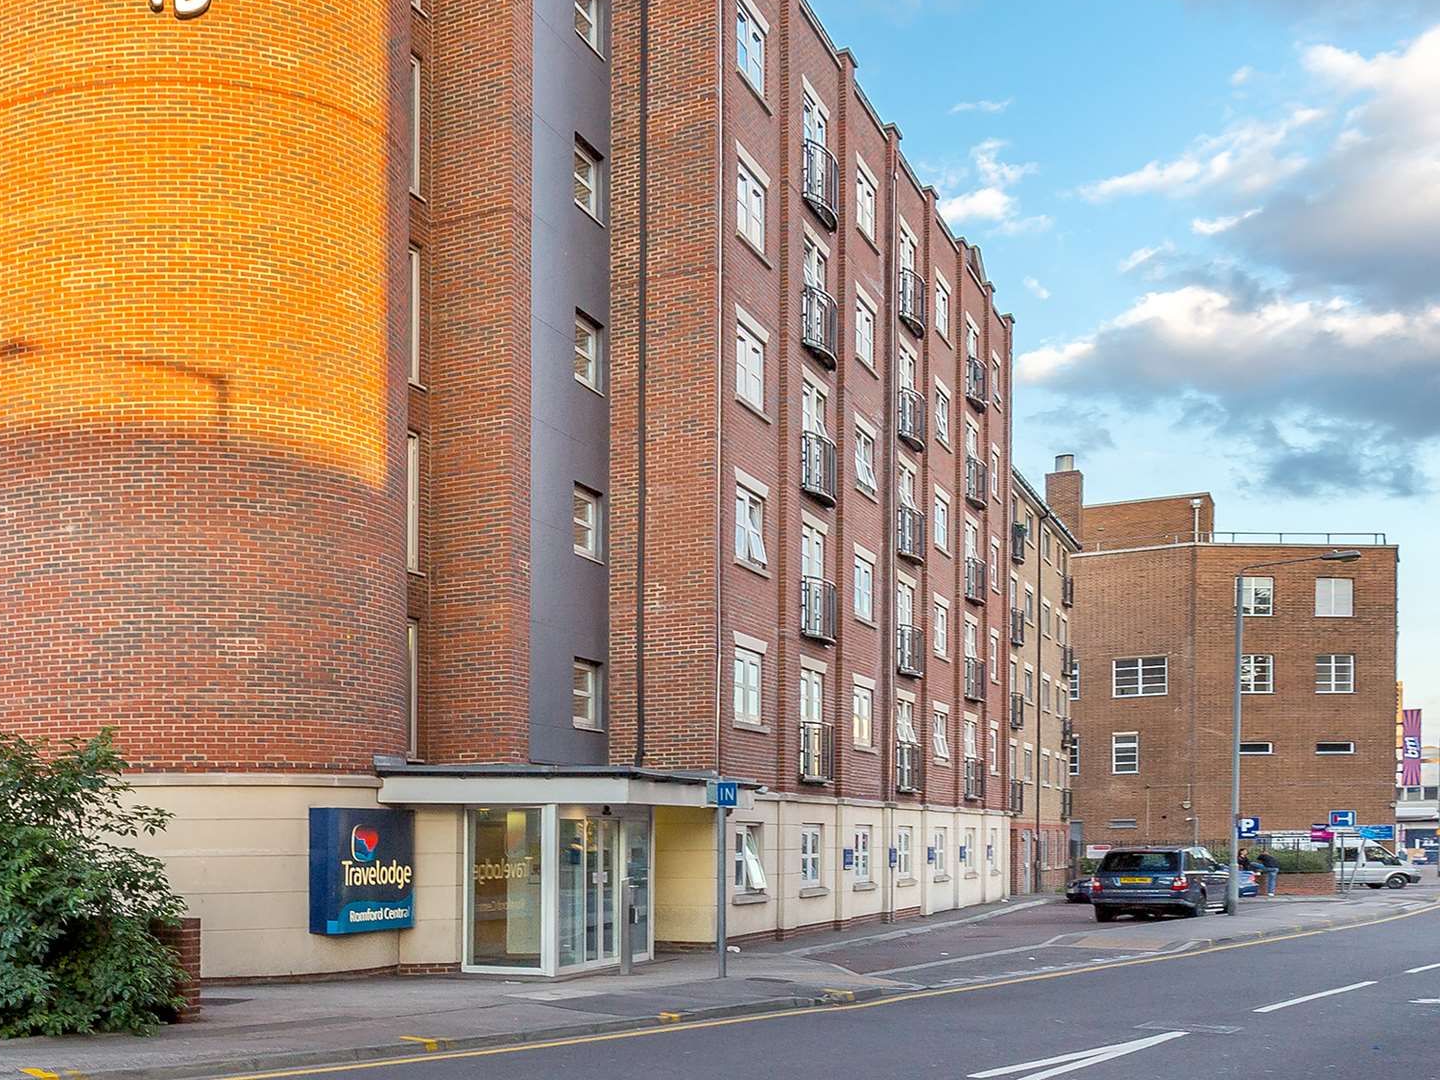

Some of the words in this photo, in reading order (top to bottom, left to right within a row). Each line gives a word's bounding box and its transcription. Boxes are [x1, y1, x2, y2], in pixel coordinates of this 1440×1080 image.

[720, 787, 734, 801] IN
[1241, 818, 1255, 832] P
[341, 859, 412, 889] Travelodge
[349, 907, 383, 922] Romford
